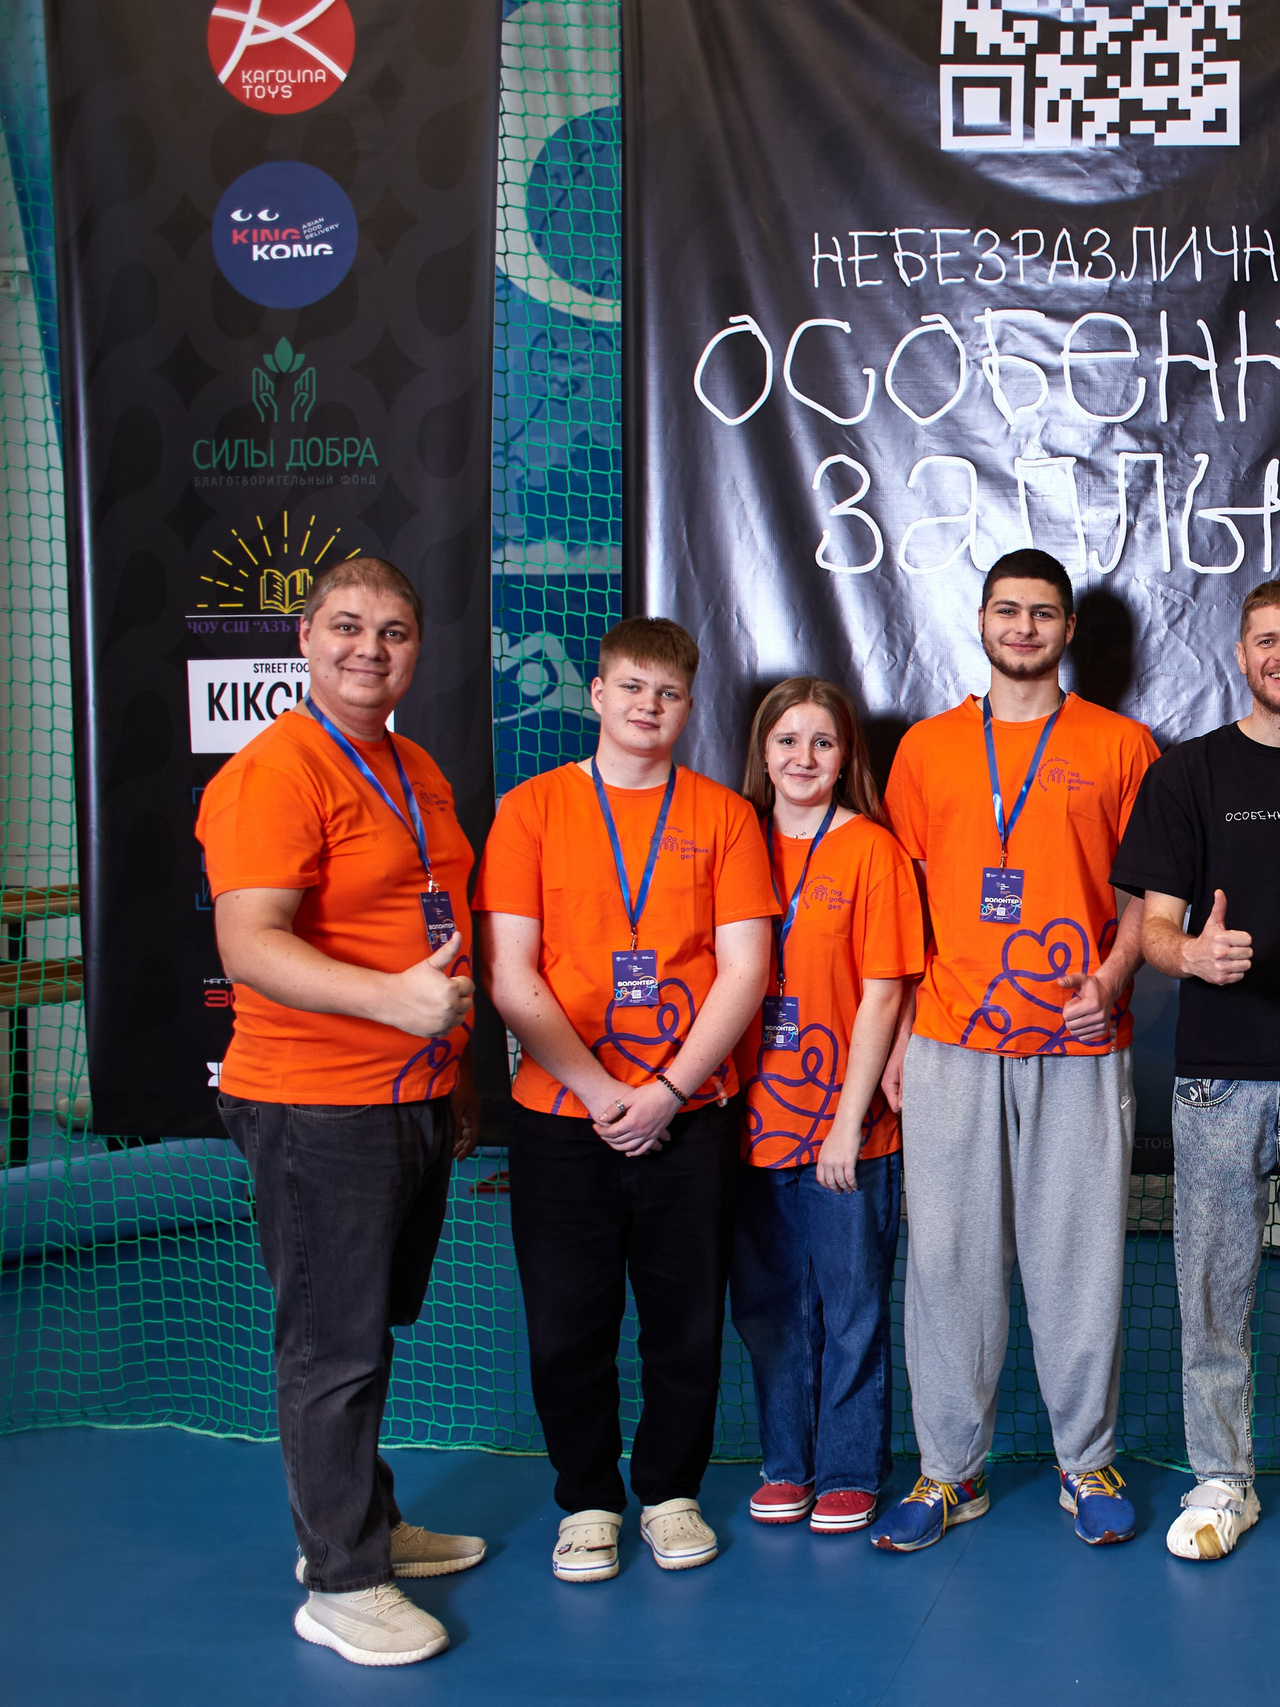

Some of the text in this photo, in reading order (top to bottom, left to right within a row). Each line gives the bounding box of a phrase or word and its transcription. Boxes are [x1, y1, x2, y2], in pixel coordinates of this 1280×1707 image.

[241, 69, 326, 83] KAROLINA
[242, 85, 293, 99] TOYS
[301, 216, 325, 230] ASIAN
[303, 224, 323, 235] FOOD
[231, 228, 301, 245] KING
[304, 222, 340, 241] DELIVERY
[252, 243, 334, 261] KONG
[193, 437, 379, 472] СИЛЫ ДОБРА
[194, 473, 376, 487] БЛАГОТВОРИТЕЛЬНЫЙ ФОНД
[187, 621, 222, 634] ЧОУ
[222, 620, 249, 633] СШ
[253, 662, 310, 673] STREET FOO
[829, 896, 852, 905] добры
